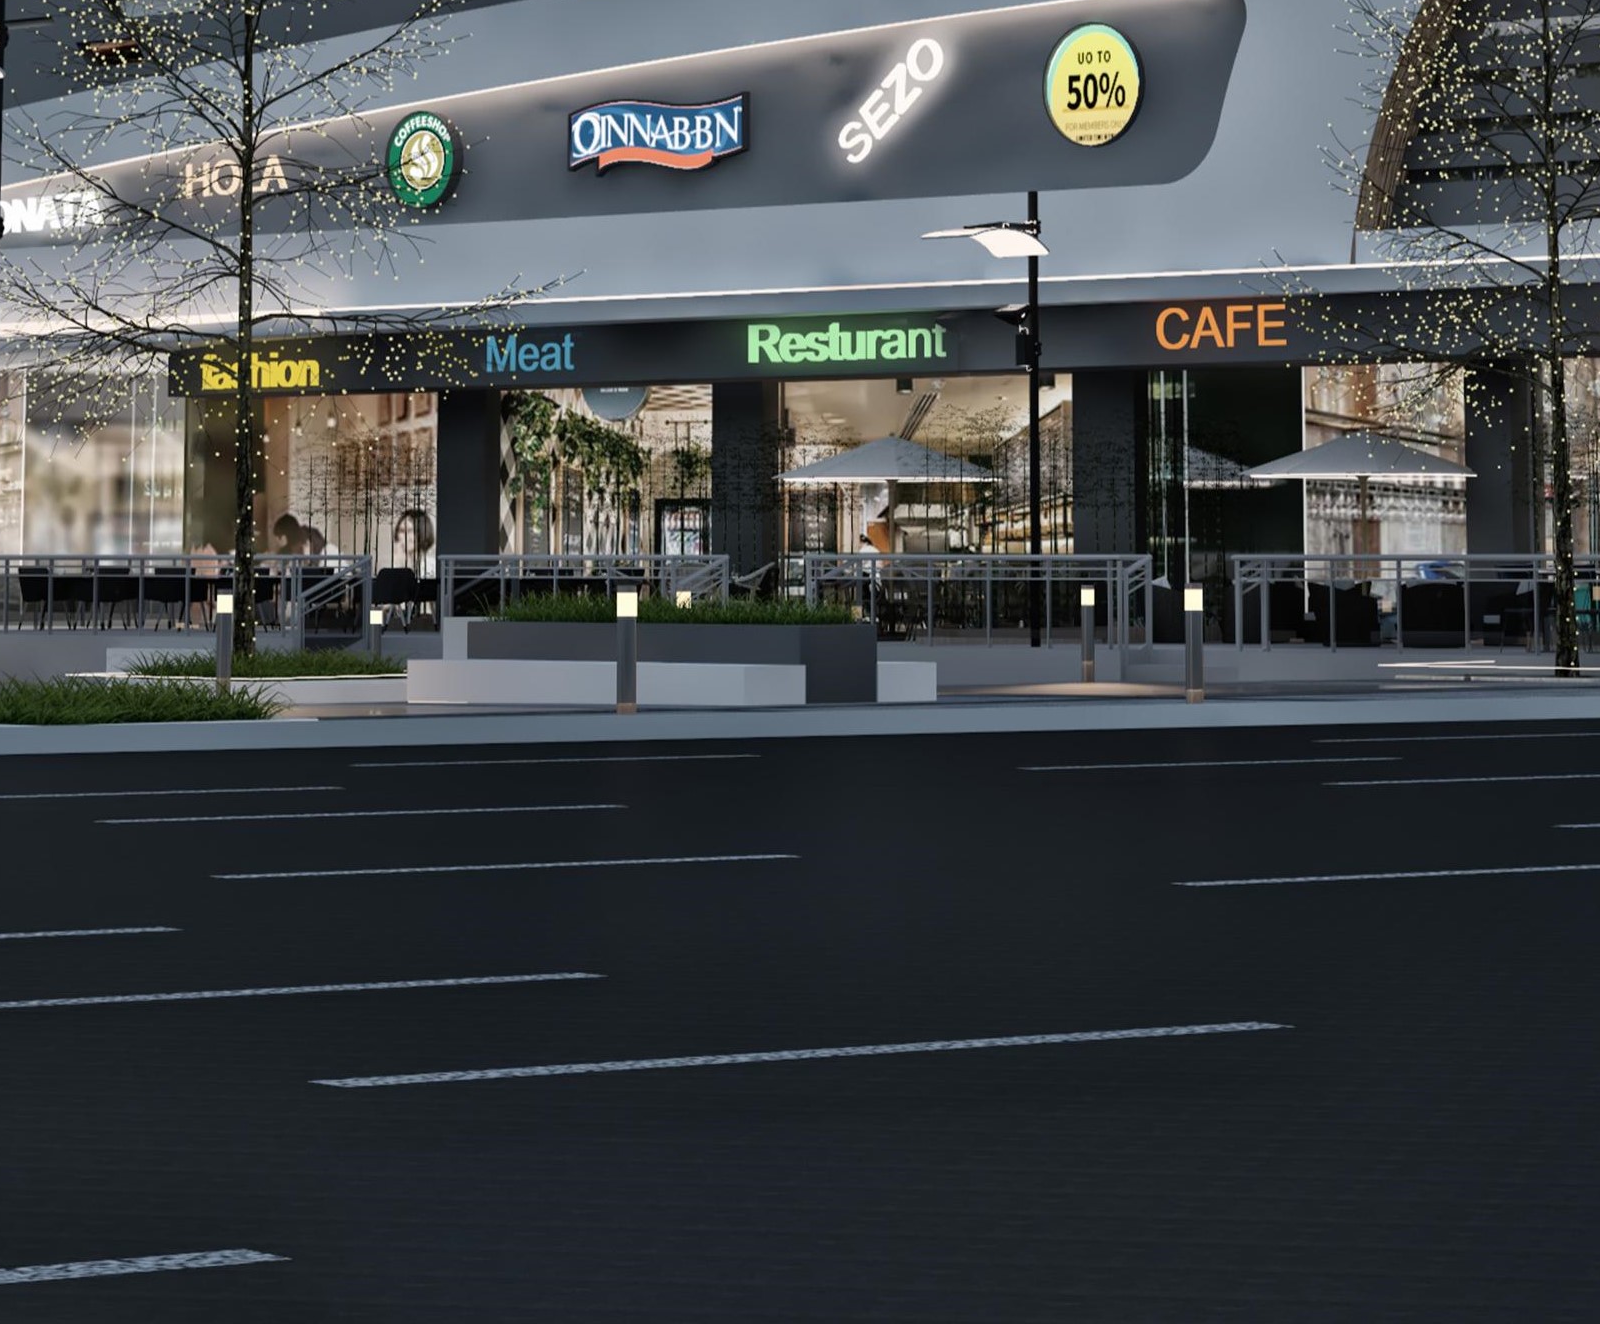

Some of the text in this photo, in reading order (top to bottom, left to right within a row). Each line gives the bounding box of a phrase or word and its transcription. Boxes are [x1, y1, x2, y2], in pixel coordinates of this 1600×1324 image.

[1078, 50, 1111, 64] UO TO
[838, 38, 943, 163] SEZO
[1067, 71, 1126, 110] 50%
[747, 322, 947, 364] Resturant
[1155, 304, 1288, 350] CAFE
[486, 333, 575, 373] Meat
